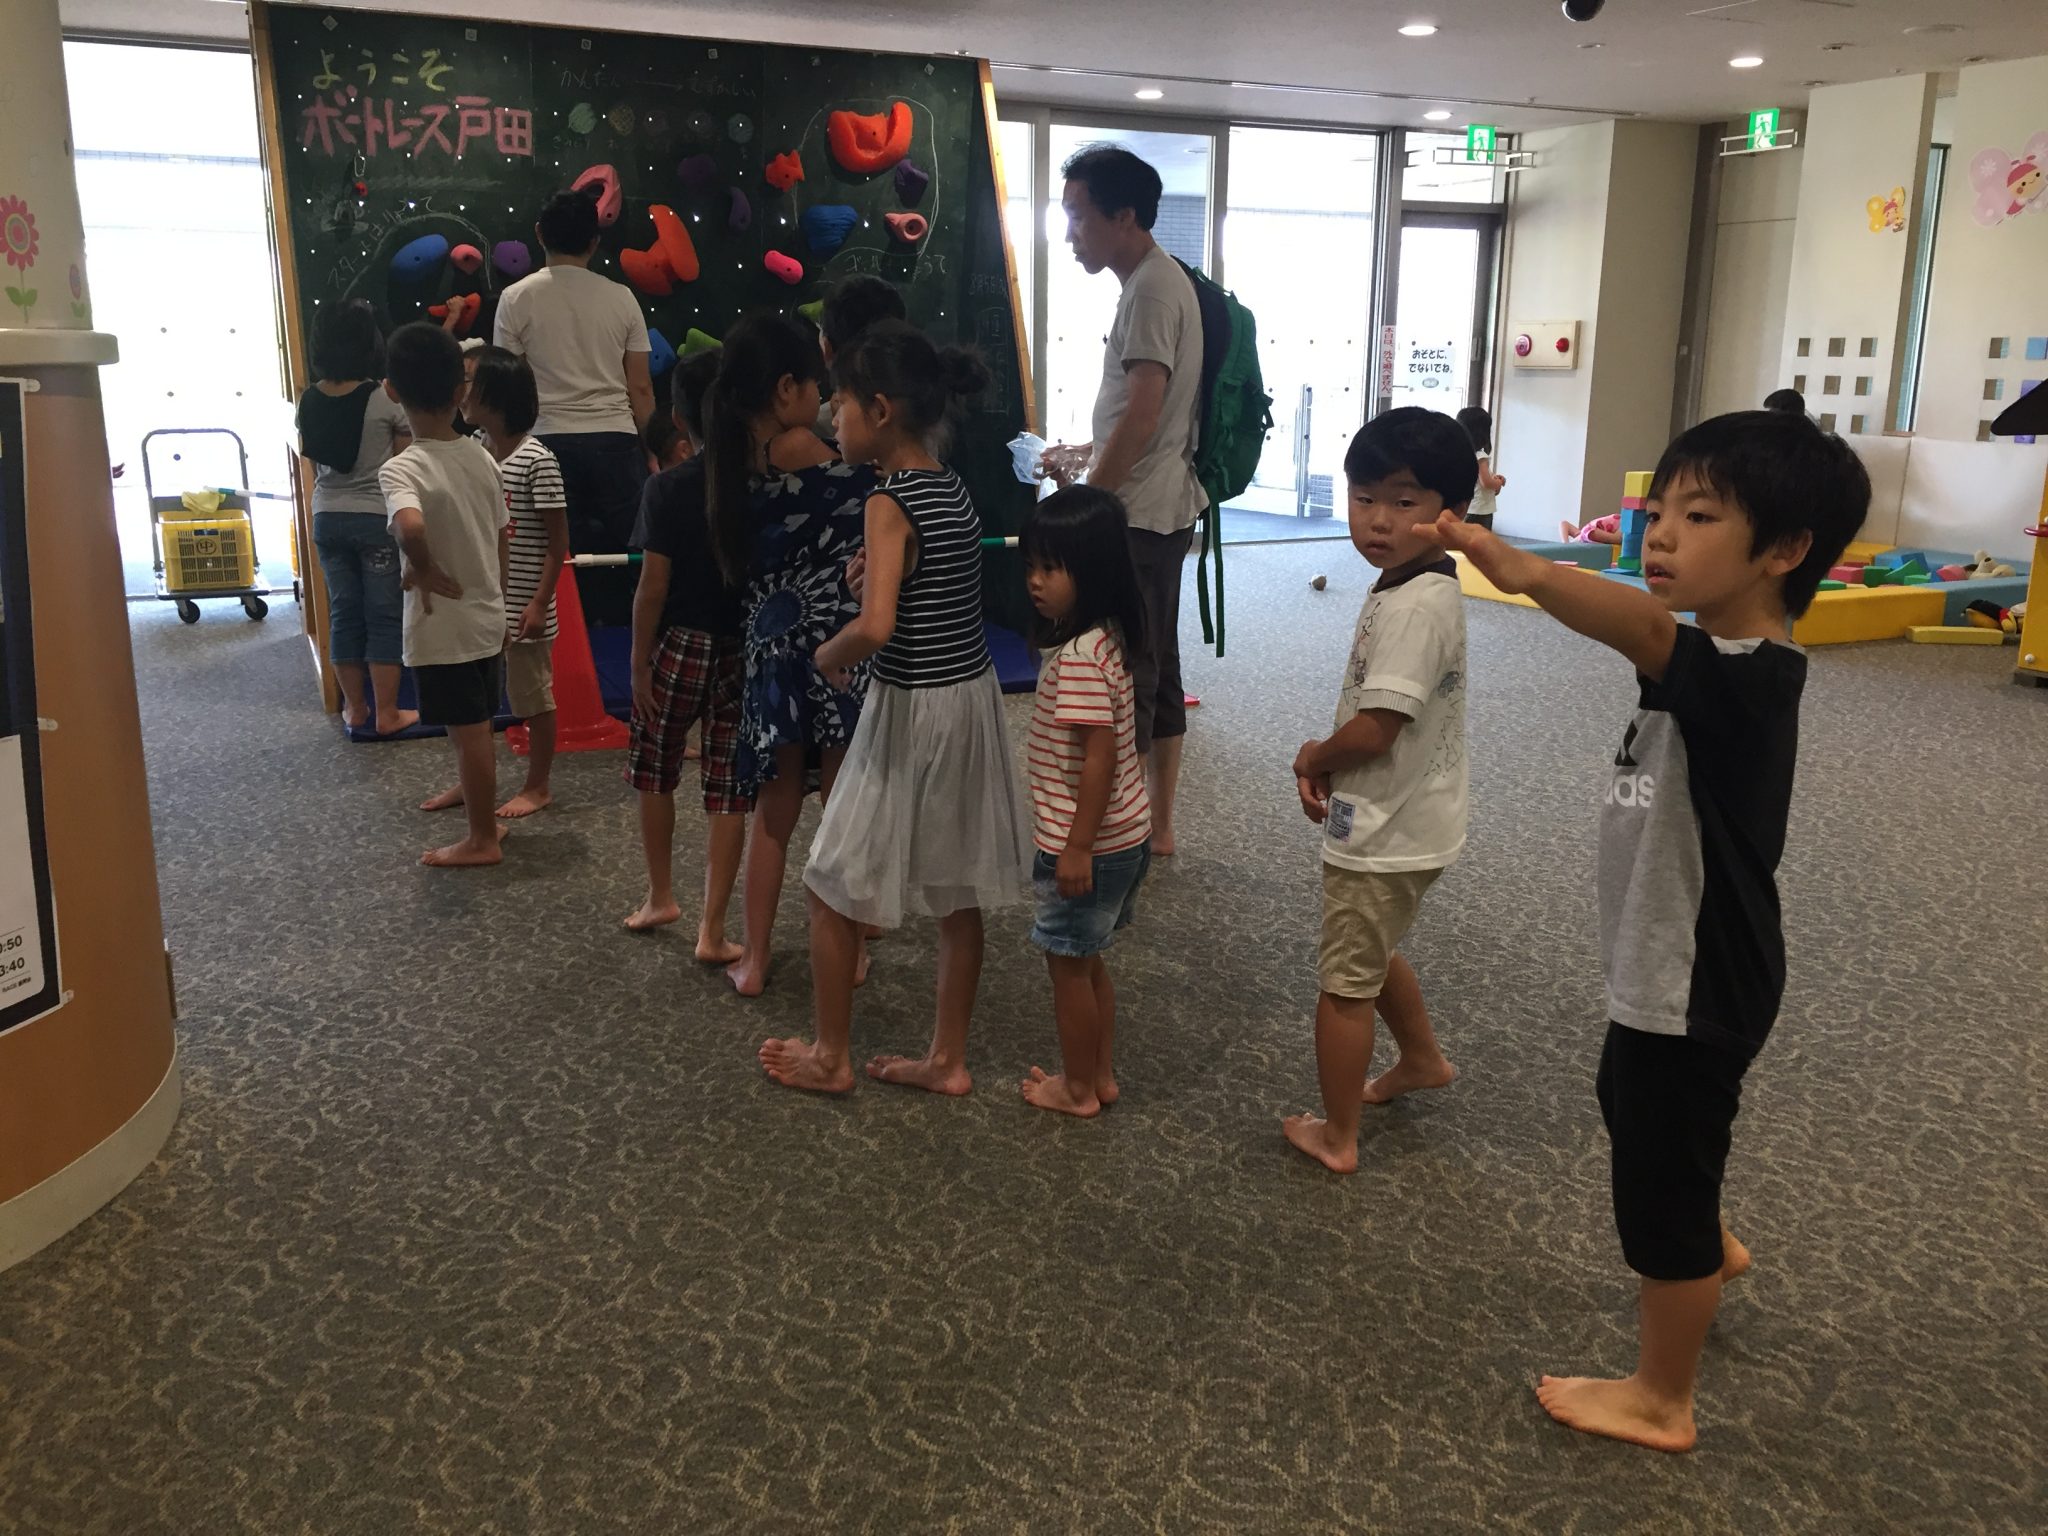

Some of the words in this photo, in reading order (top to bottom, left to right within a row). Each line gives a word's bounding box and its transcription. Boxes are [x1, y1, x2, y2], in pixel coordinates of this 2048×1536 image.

[312, 48, 454, 92] ようこそ
[560, 67, 622, 90] かんたん
[301, 84, 533, 163] ボートレース戸田
